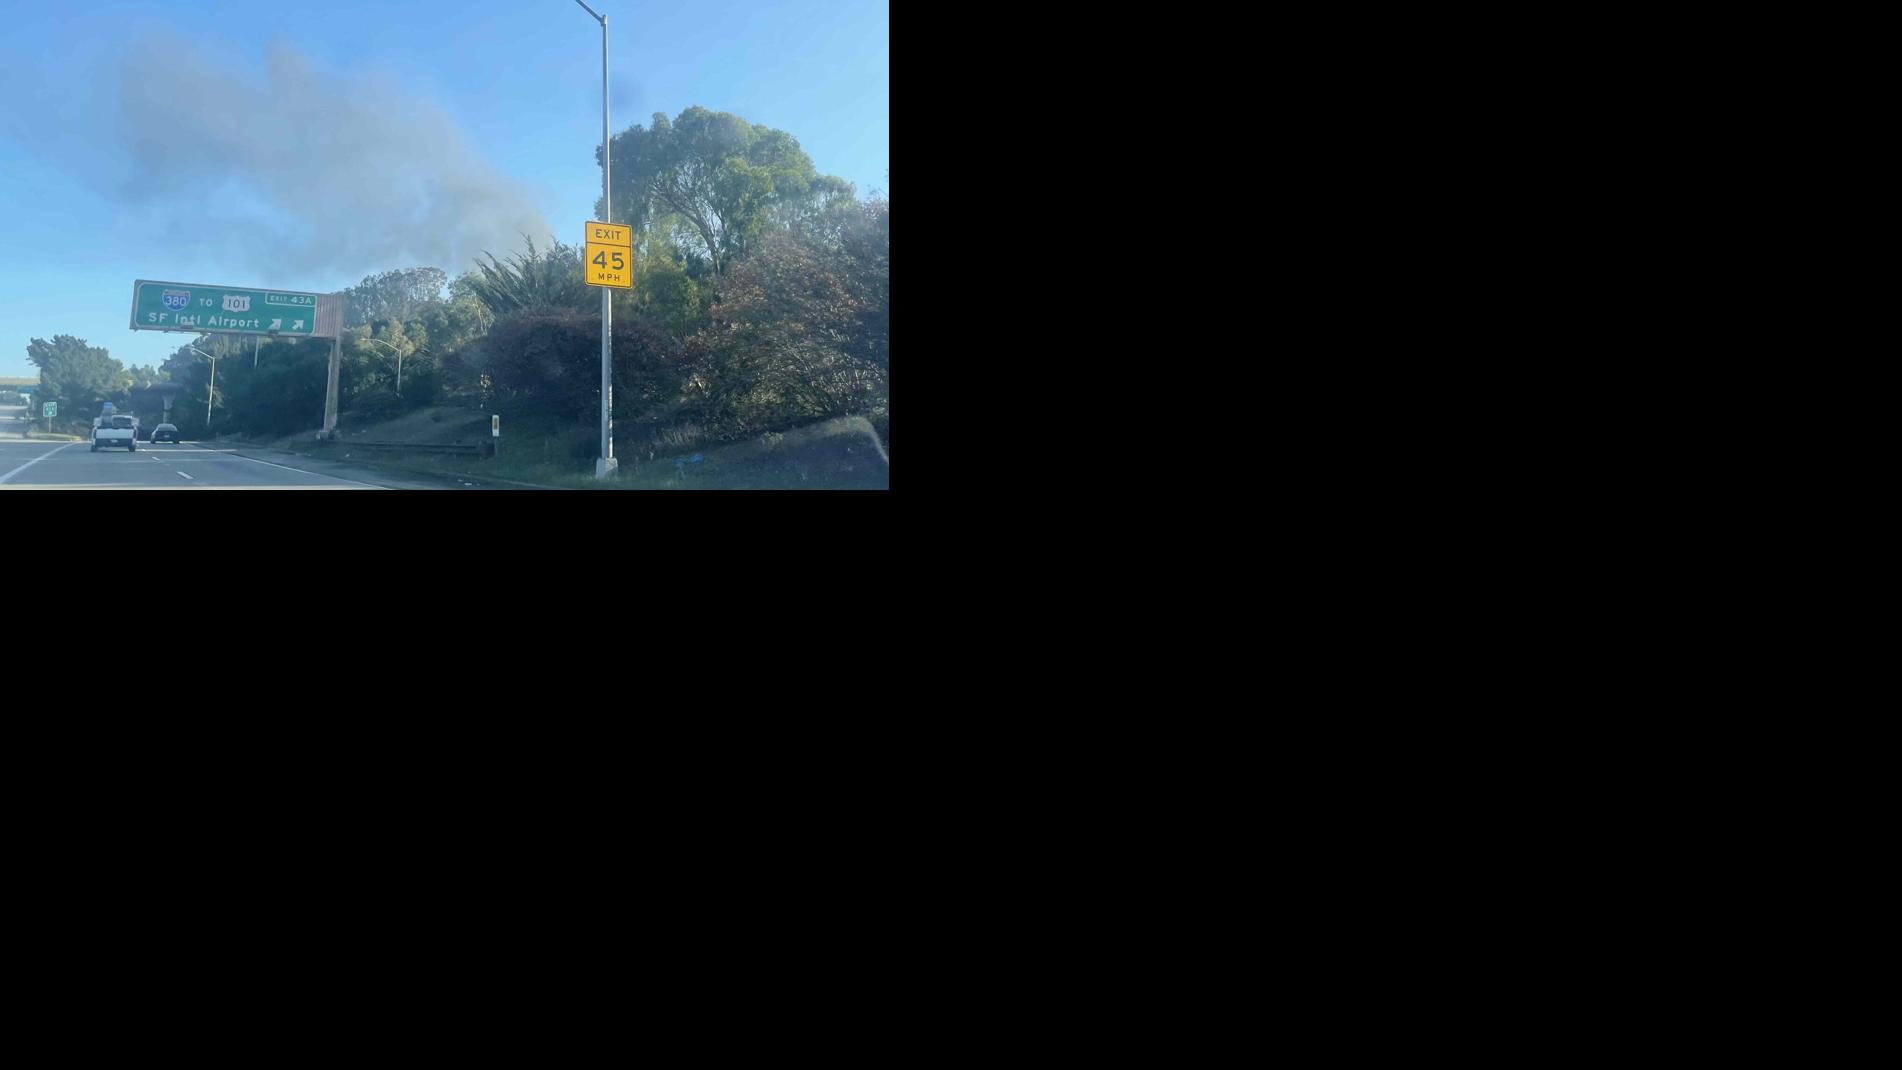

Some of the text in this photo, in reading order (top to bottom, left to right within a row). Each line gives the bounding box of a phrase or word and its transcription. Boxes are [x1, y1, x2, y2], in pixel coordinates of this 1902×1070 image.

[595, 229, 621, 240] EXIT
[592, 250, 624, 270] 45
[598, 273, 620, 281] MPH
[165, 296, 245, 309] 380 TO 101
[290, 296, 312, 304] 43A
[148, 312, 168, 323] SF
[208, 315, 259, 328] Airport
